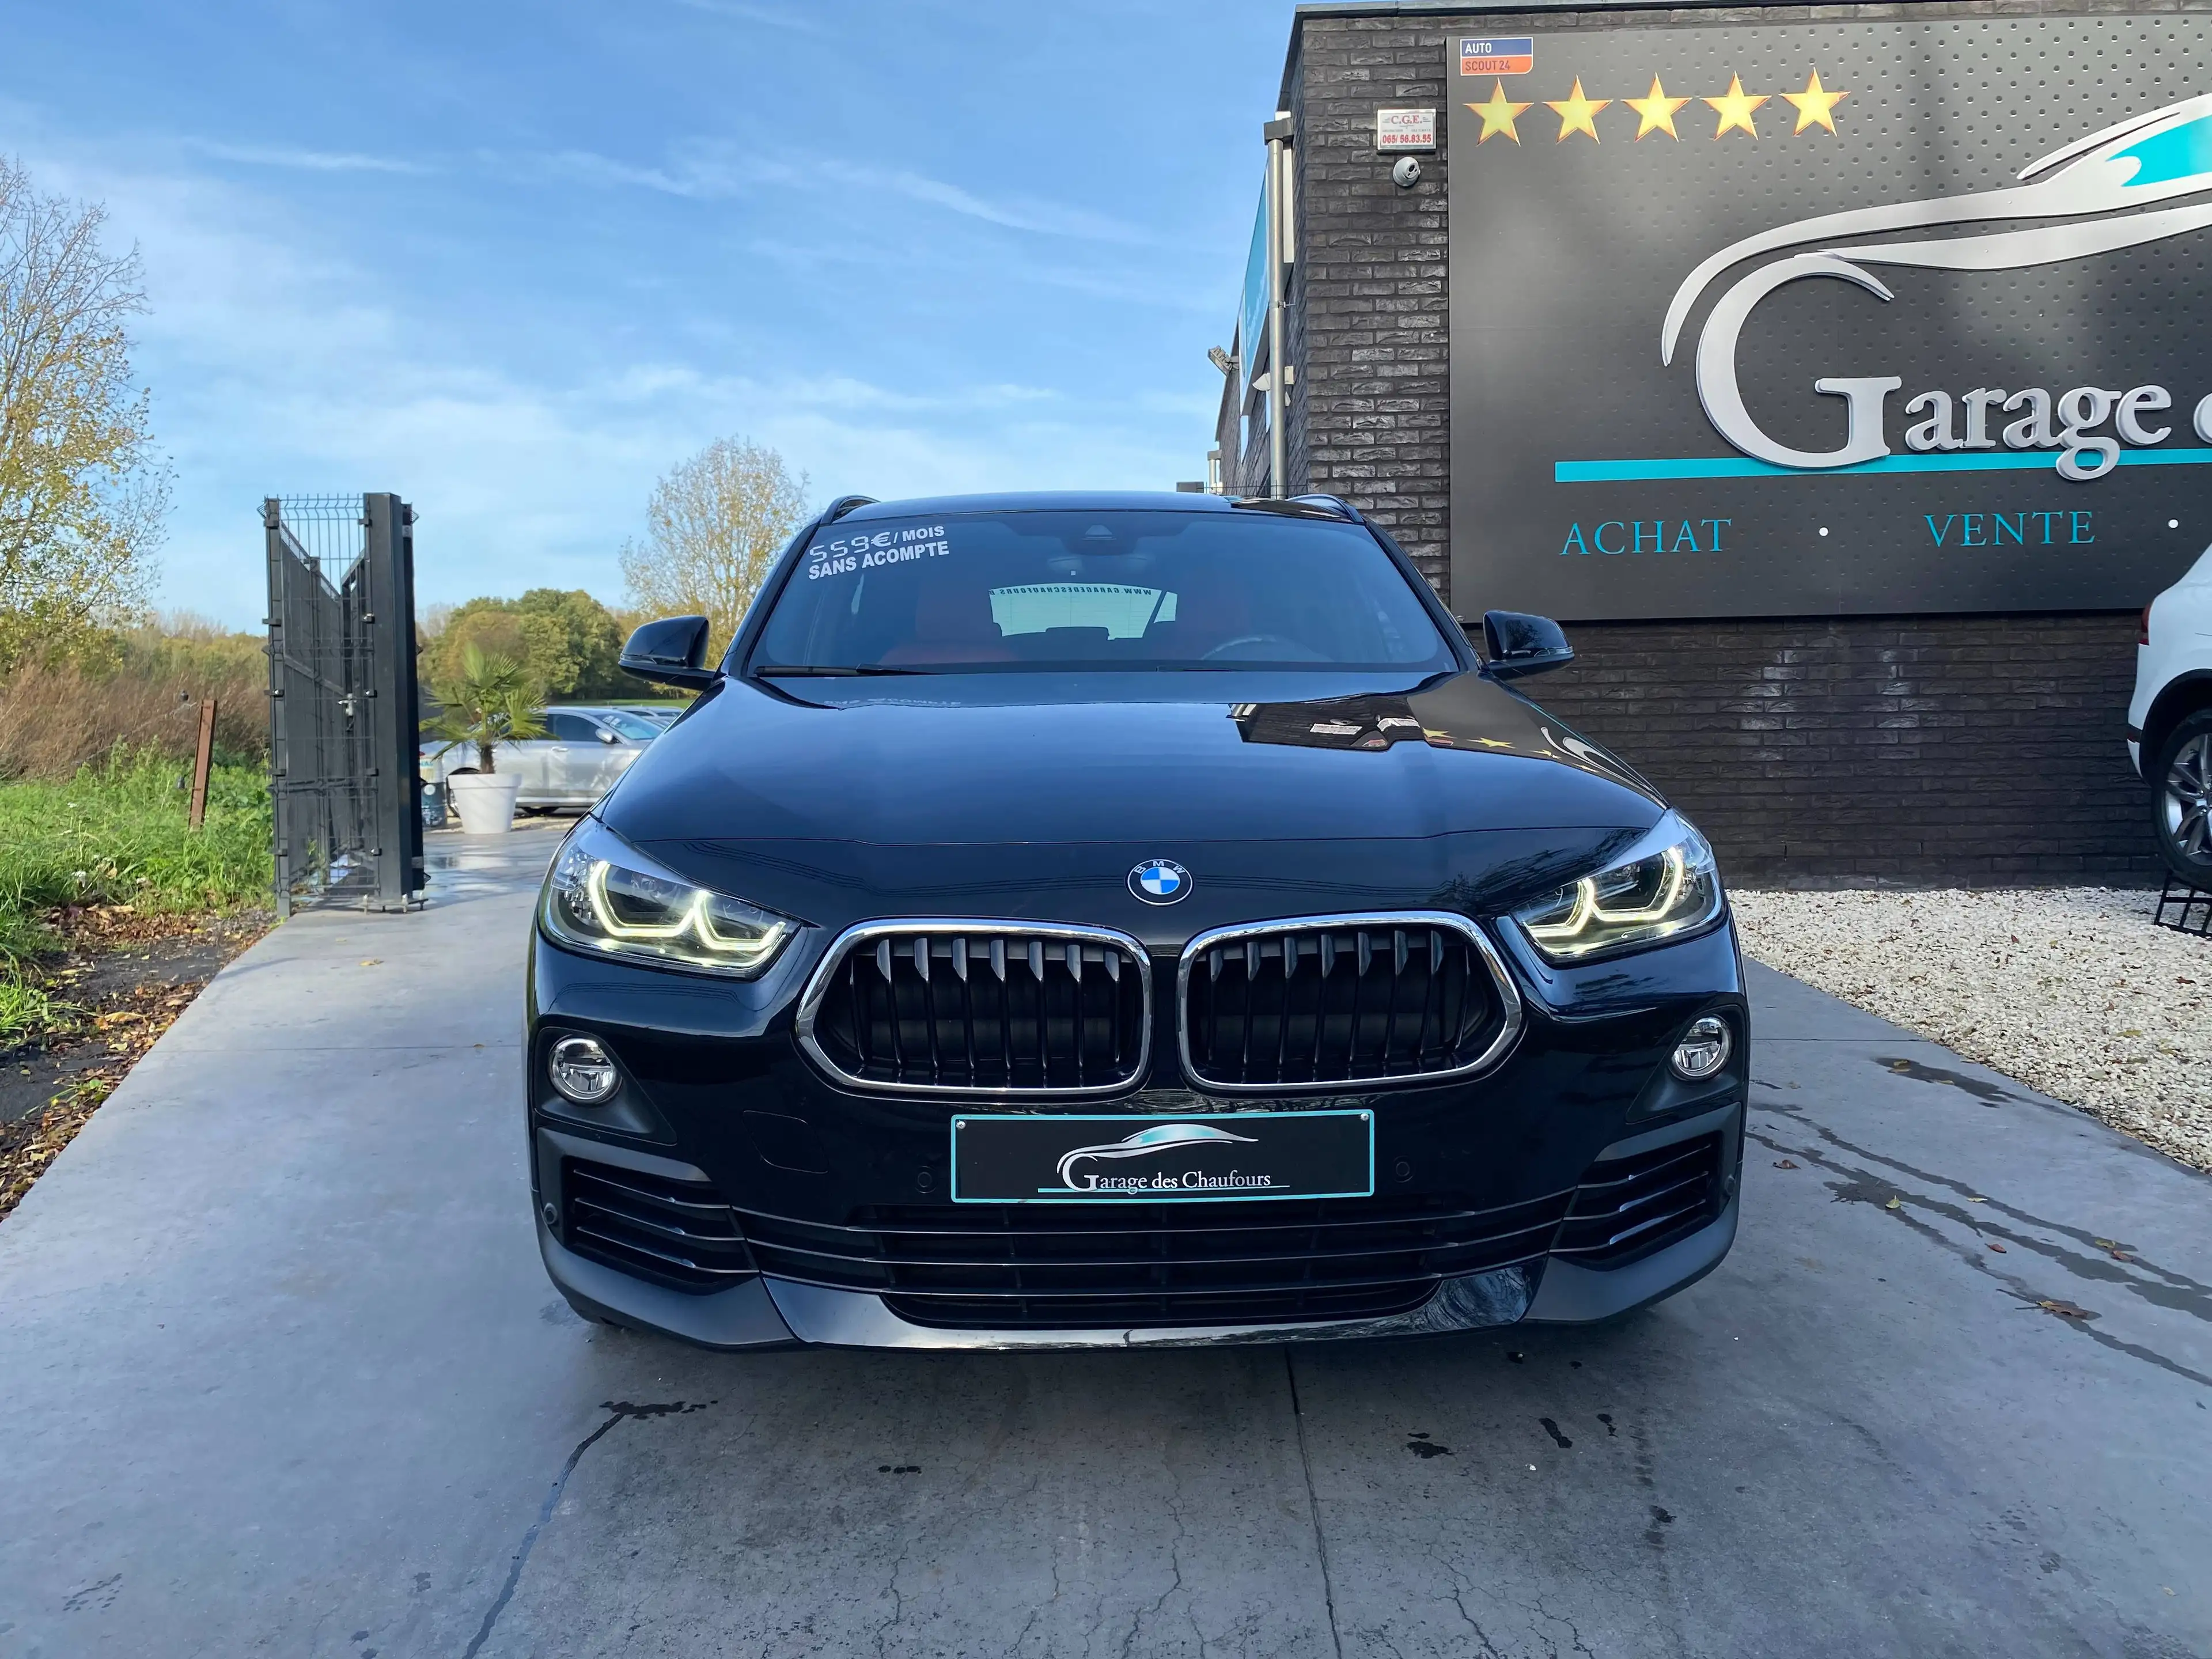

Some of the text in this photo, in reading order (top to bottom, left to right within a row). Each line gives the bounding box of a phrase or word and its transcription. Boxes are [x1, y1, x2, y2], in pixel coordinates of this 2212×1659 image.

[1465, 43, 1492, 54] AUTO
[1465, 60, 1510, 71] SCOUT 24
[1391, 115, 1422, 124] C.G.E.
[1696, 250, 2172, 481] Garage
[1559, 510, 2096, 555] ACHAT VENTE
[809, 540, 949, 580] SANS ACOMPTE
[1134, 861, 1185, 874] BMW
[1062, 1153, 1271, 1195] Garage des Chaufours
